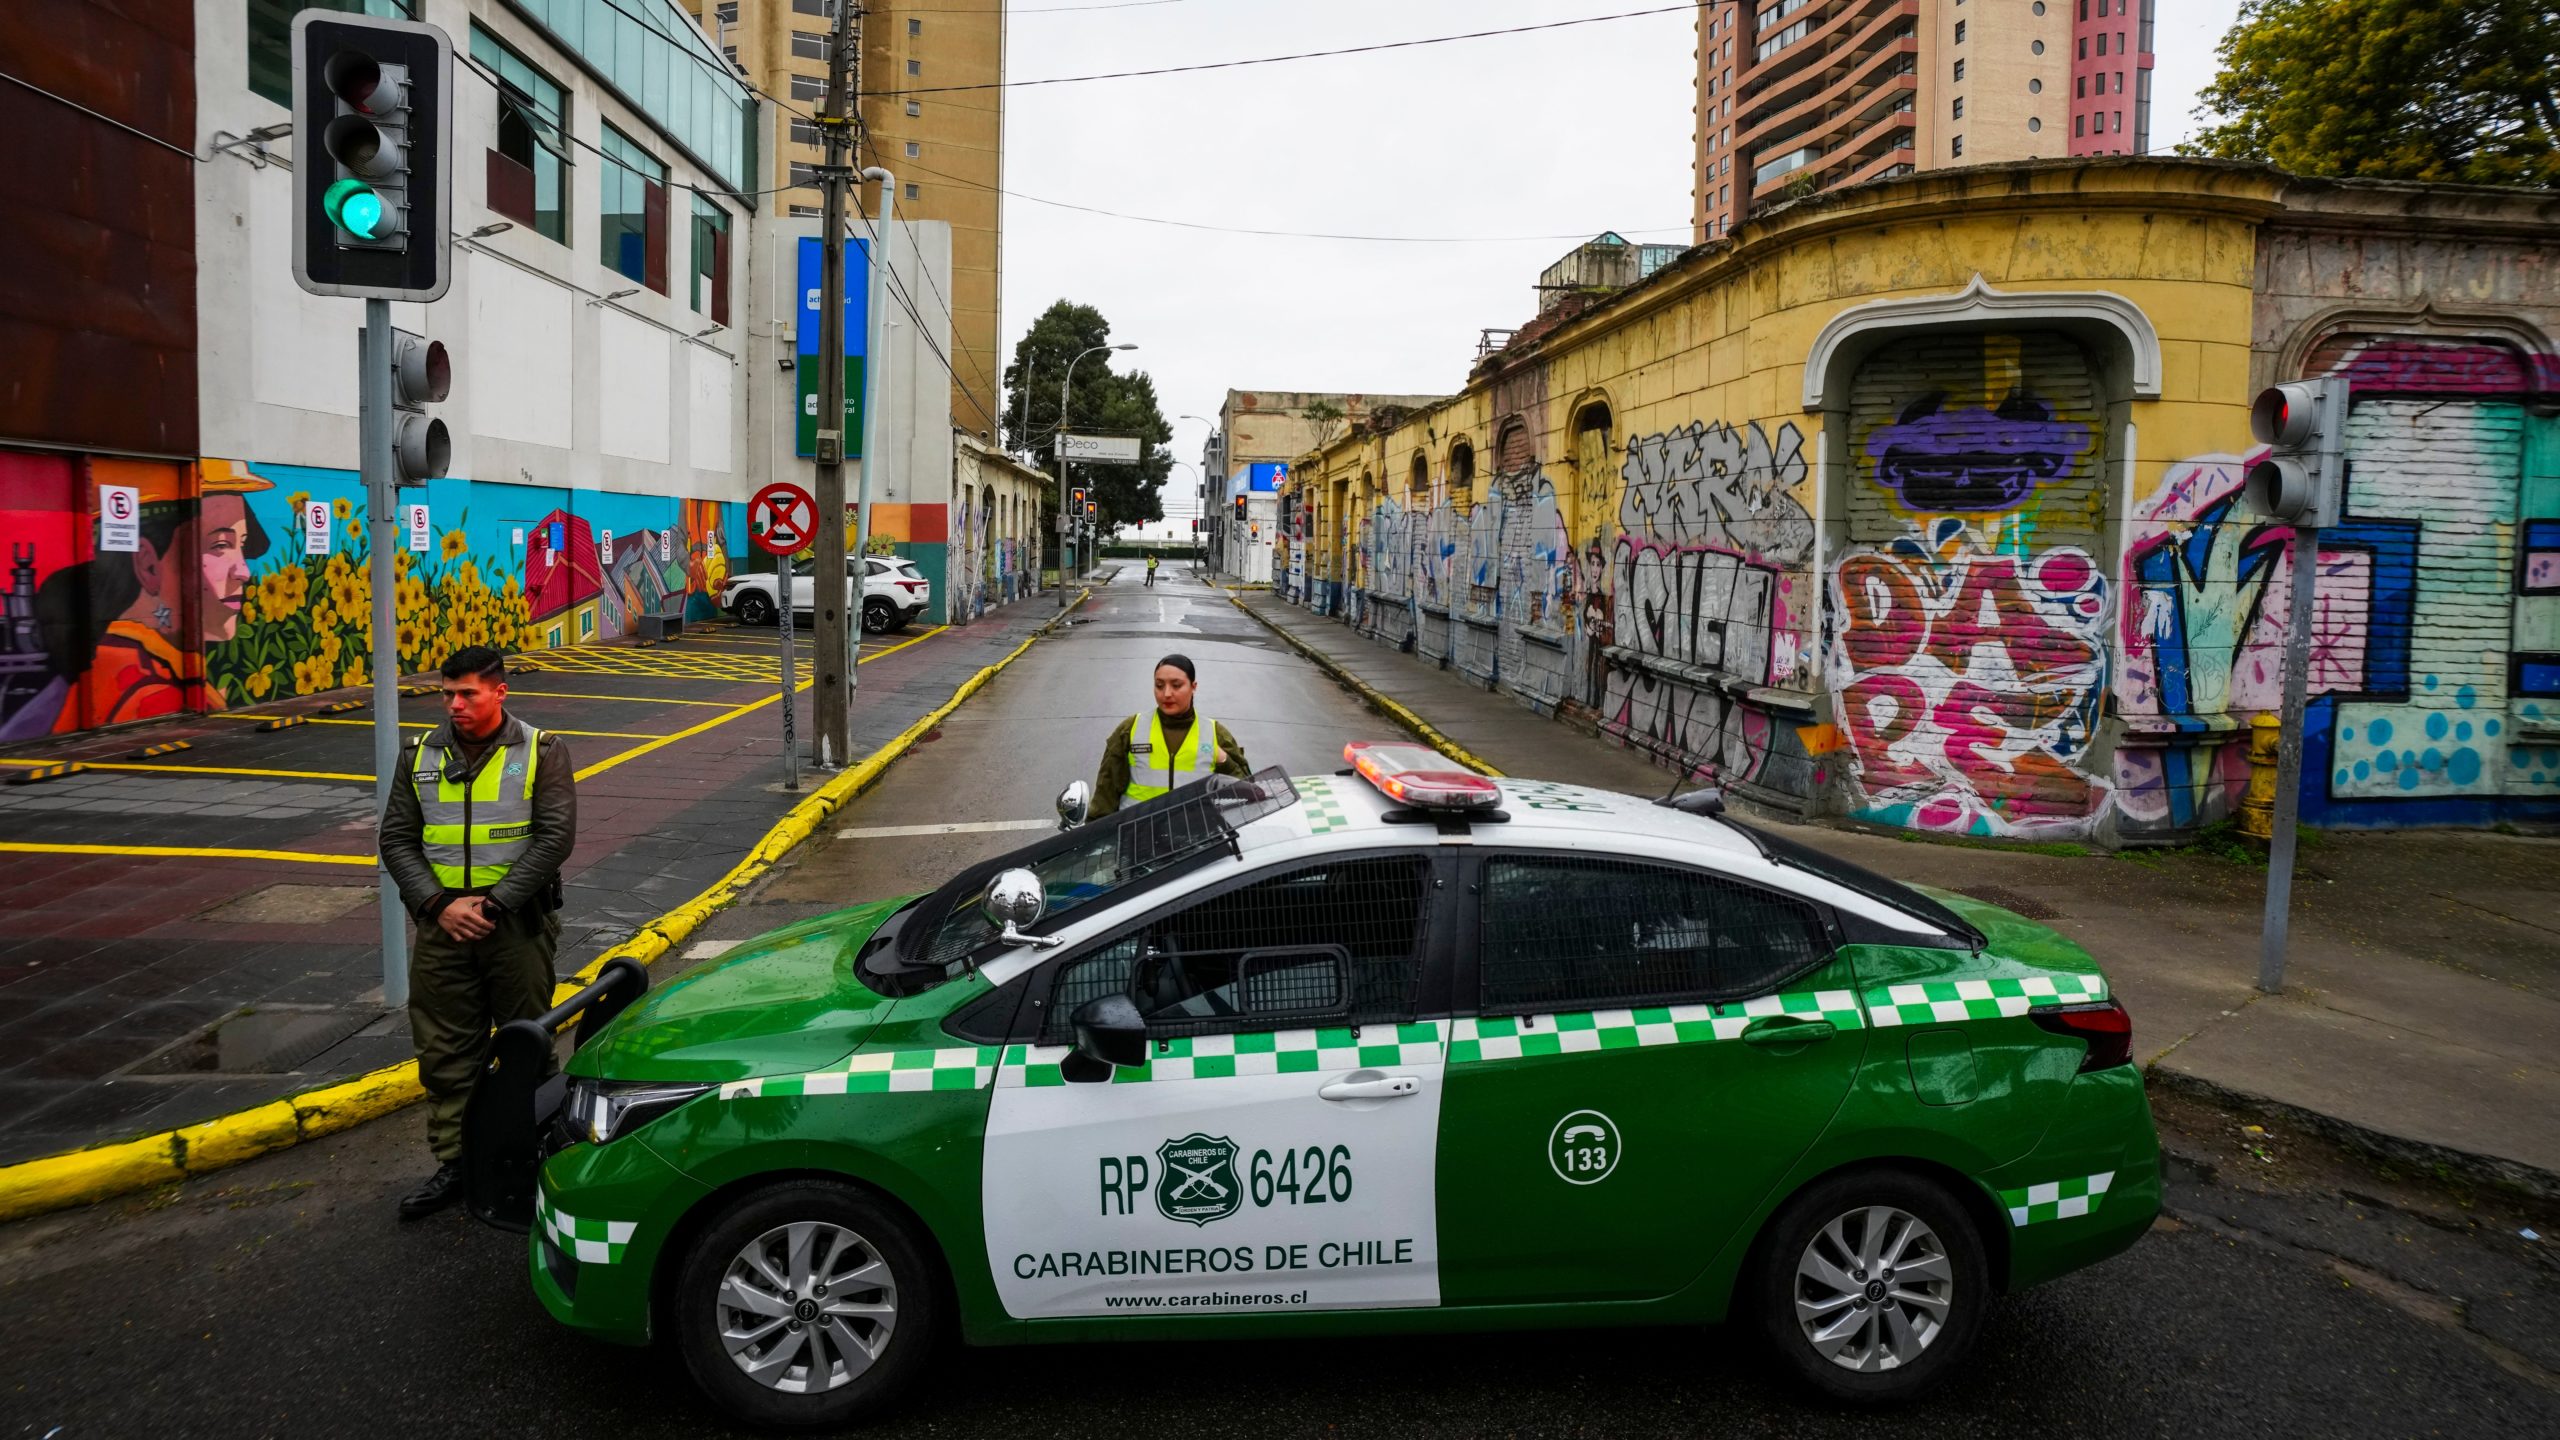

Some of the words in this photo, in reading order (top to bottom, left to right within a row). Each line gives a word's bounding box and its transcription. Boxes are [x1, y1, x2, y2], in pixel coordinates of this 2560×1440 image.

[1169, 1148, 1217, 1158] CARABINEROS
[1218, 1148, 1227, 1156] DE
[1188, 1156, 1208, 1165] CHILE
[1564, 1147, 1607, 1172] 133
[1100, 1156, 1148, 1216] RP
[1250, 1144, 1352, 1208] 6426
[1013, 1246, 1254, 1280] CARABINEROS
[1265, 1245, 1308, 1270] DE
[1318, 1239, 1413, 1268] CHILE
[1105, 1290, 1308, 1308] www.carabineros.cl
